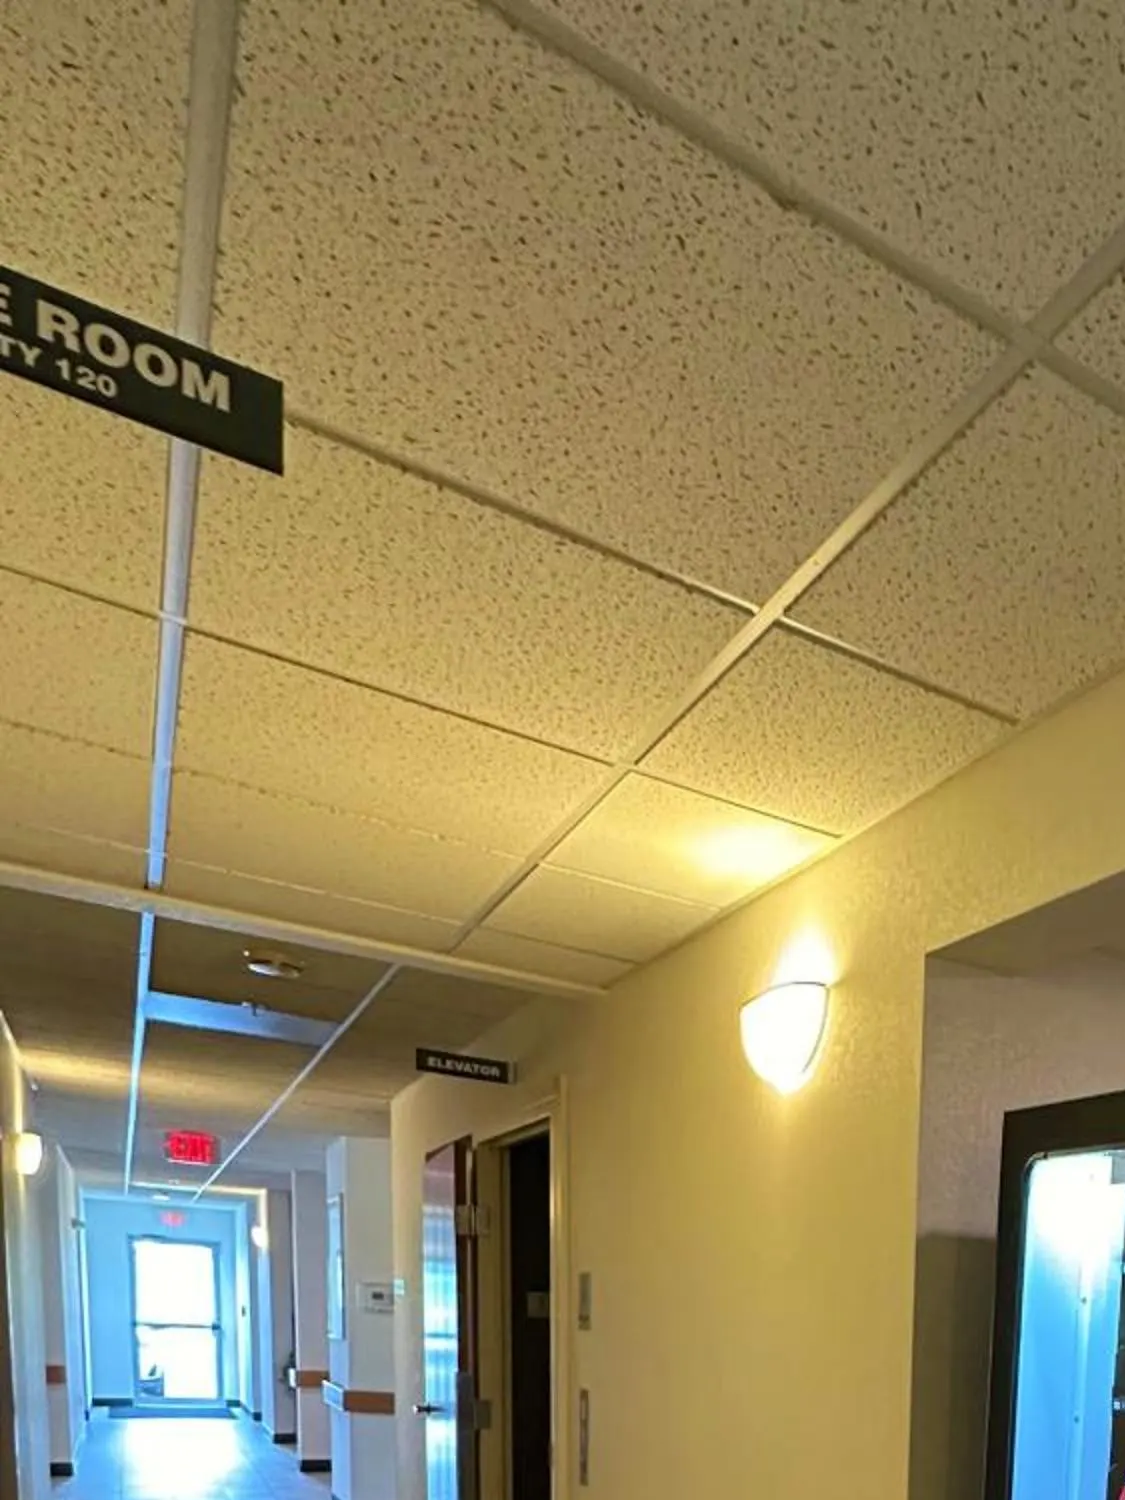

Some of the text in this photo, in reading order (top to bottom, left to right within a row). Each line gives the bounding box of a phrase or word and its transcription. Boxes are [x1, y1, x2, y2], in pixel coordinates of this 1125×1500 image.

[36, 299, 231, 413] ROOM
[55, 358, 118, 398] 120
[427, 1056, 501, 1077] ELEVATOR
